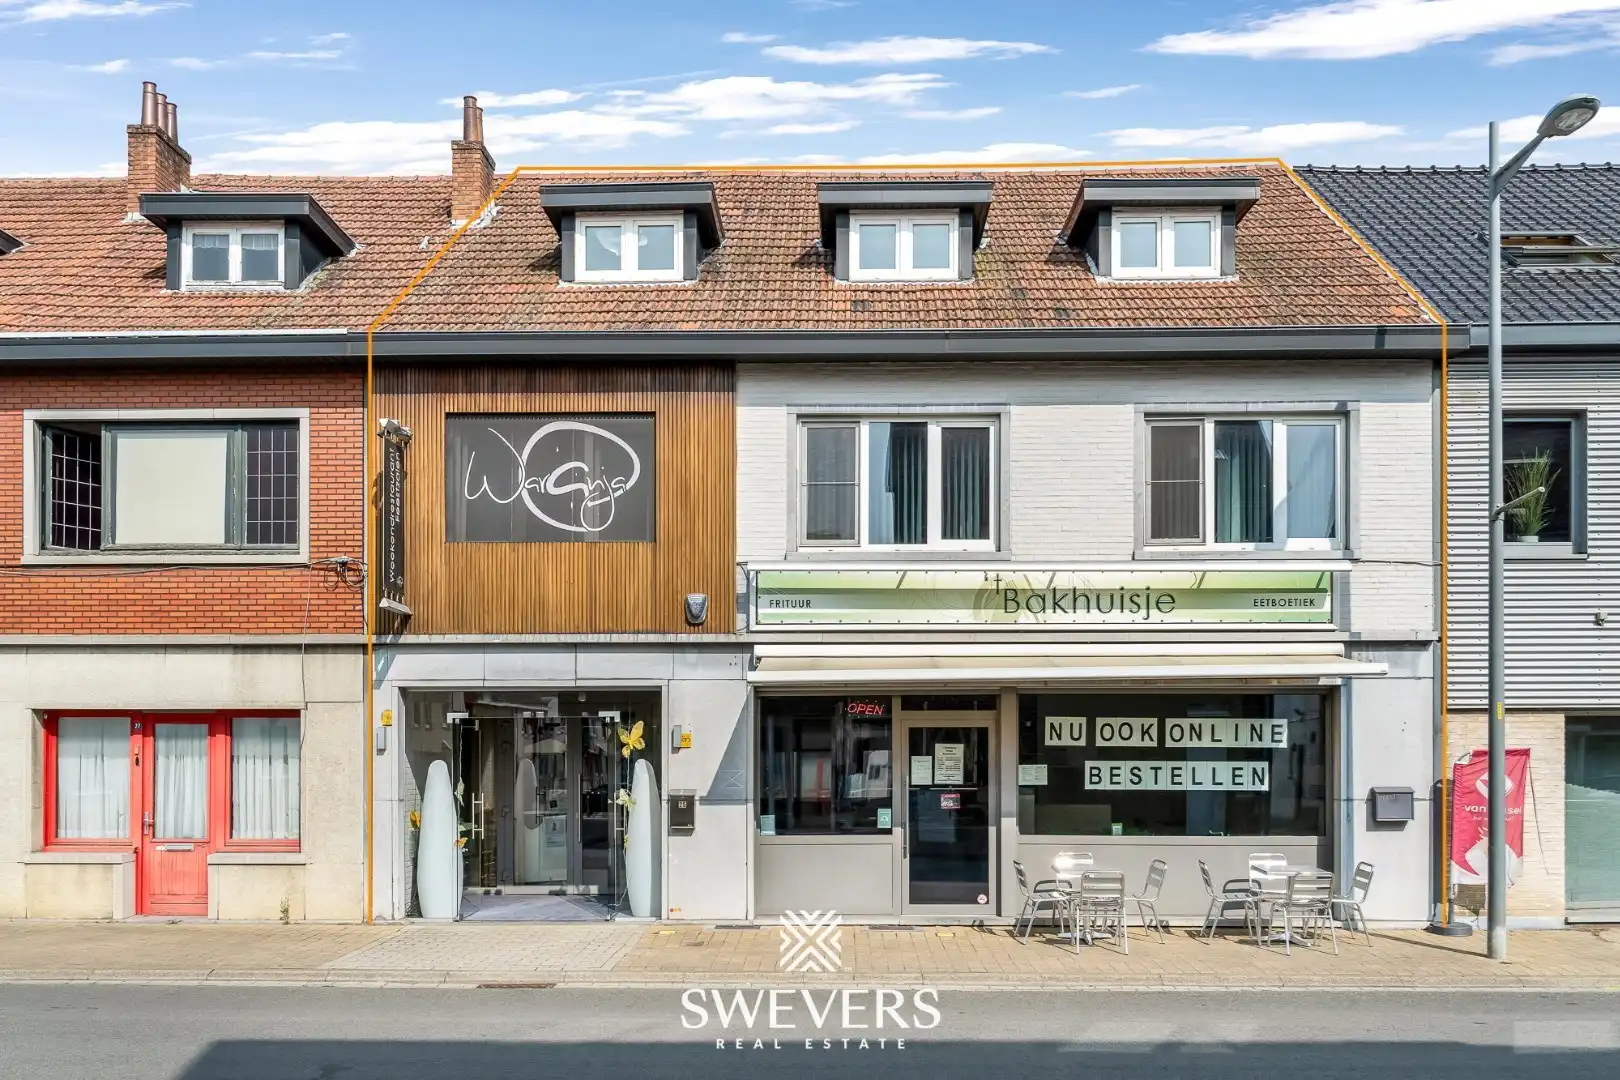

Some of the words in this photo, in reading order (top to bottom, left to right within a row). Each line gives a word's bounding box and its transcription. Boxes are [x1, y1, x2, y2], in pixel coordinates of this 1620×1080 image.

[769, 599, 812, 608] FRITUUR
[1004, 586, 1176, 621] Bakhuisje
[1253, 598, 1316, 607] EETBOETIEK
[847, 703, 884, 715] OPEN
[1049, 721, 1083, 742] NU
[1099, 721, 1156, 743] OOK
[1168, 722, 1285, 744] ONLINE
[1088, 765, 1266, 786] BESTELLEN
